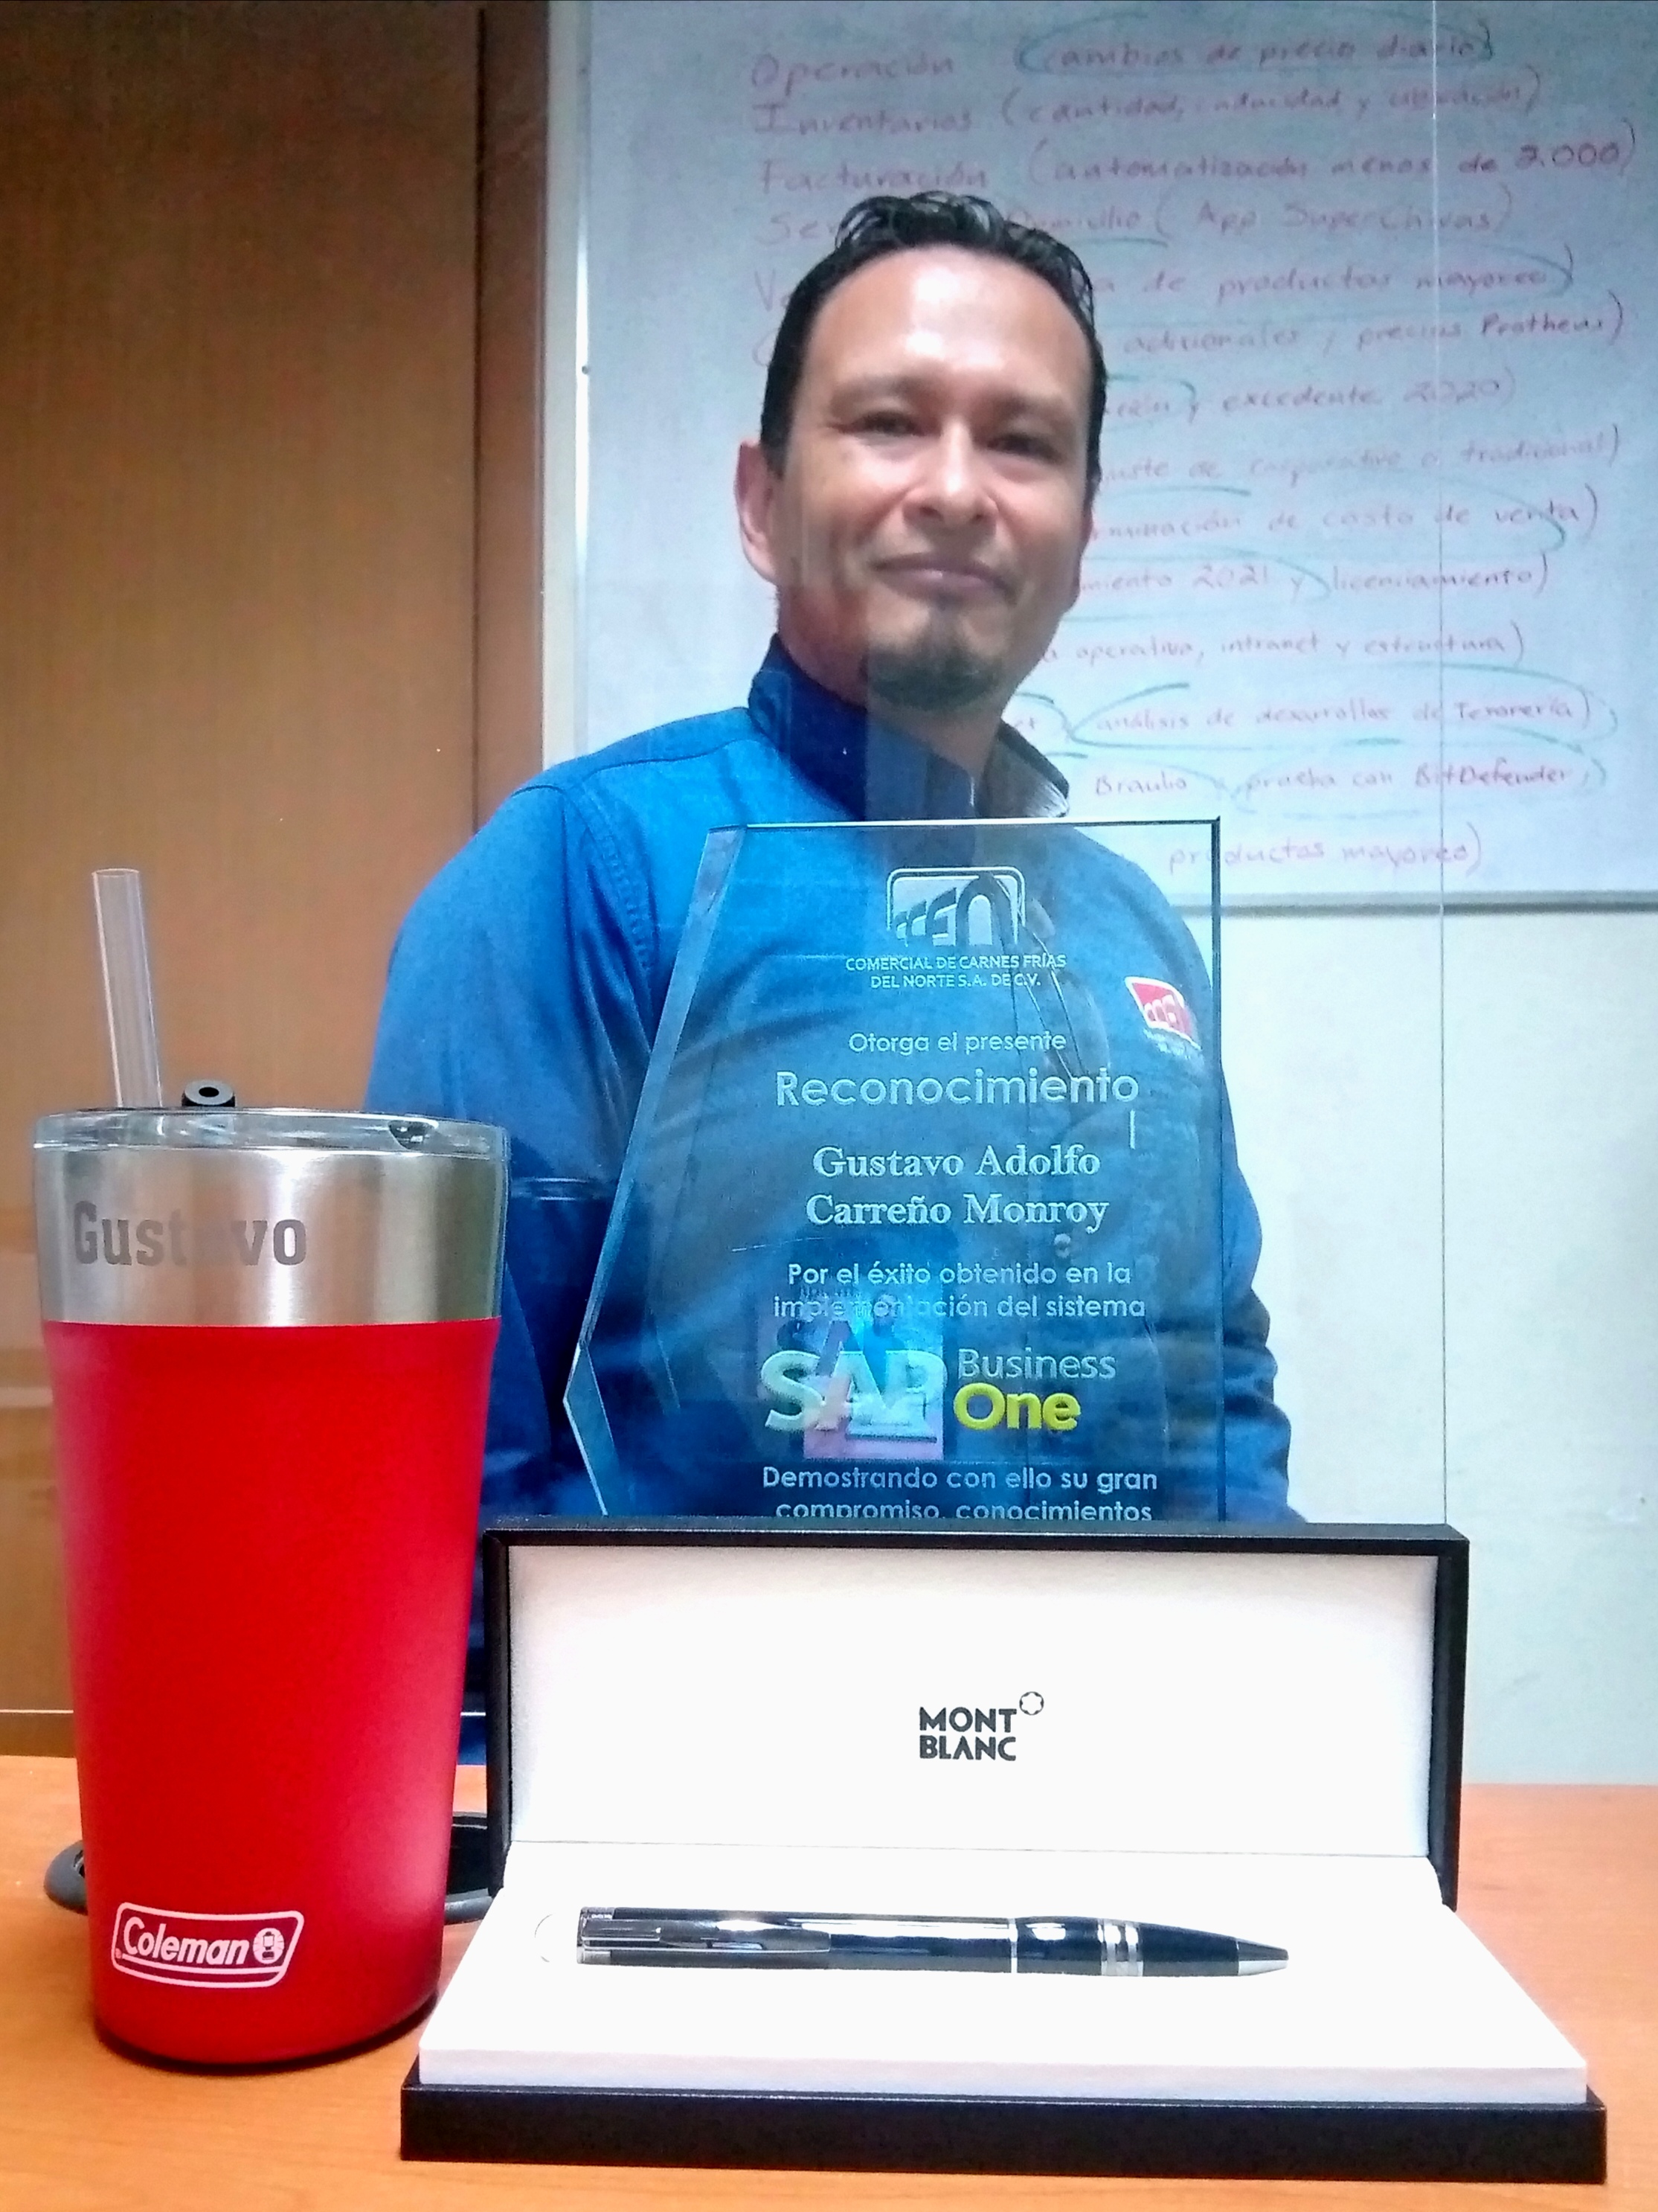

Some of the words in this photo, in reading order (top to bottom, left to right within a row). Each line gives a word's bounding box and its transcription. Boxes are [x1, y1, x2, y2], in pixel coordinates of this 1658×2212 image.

[1259, 40, 1355, 68] precio
[1331, 156, 1432, 175] menos
[1457, 153, 1498, 173] de
[1217, 266, 1390, 307] productos
[1192, 562, 1268, 590] 2021
[1221, 629, 1319, 654] intranet
[1336, 638, 1352, 661] y
[1206, 706, 1233, 727] de
[1095, 769, 1188, 795] Braulio
[1352, 771, 1394, 788] con
[846, 957, 933, 972] COMERCIAL
[936, 956, 957, 969] DE
[960, 955, 1020, 969] CARNES
[1022, 953, 1067, 968] FRÍAS
[871, 975, 900, 989] DEL
[903, 975, 955, 988] NORTE
[957, 974, 988, 987] S.A.
[991, 973, 1012, 987] DE
[848, 1032, 930, 1055] Otorga
[937, 1031, 958, 1051] el
[965, 1030, 1067, 1055] presente
[776, 1068, 1139, 1106] Reconocimiento
[813, 1147, 964, 1177] Gustavo
[975, 1144, 1101, 1176] Adolfo
[806, 1193, 951, 1225] Carreño
[963, 1193, 1110, 1234] Monroy
[74, 1200, 307, 1266] Gustvo
[788, 1263, 829, 1284] Por
[835, 1263, 859, 1283] el
[867, 1260, 931, 1284] éxito
[939, 1263, 1057, 1284] obtenido
[1064, 1267, 1099, 1283] en
[1106, 1263, 1131, 1283] la
[996, 1296, 1038, 1318] del
[1045, 1295, 1146, 1317] sistema
[957, 1347, 1116, 1379] Business
[759, 1349, 948, 1432] SAP
[954, 1382, 1082, 1432] One
[762, 1466, 938, 1489] Demostrando
[946, 1472, 996, 1488] con
[1005, 1466, 1052, 1488] ello
[1061, 1472, 1088, 1488] su
[1096, 1472, 1157, 1494] gran
[955, 1500, 1153, 1520] conocimientos
[919, 1706, 1018, 1733] MONT
[919, 1734, 1017, 1761] BLANC
[123, 1916, 250, 1965] Coleman
